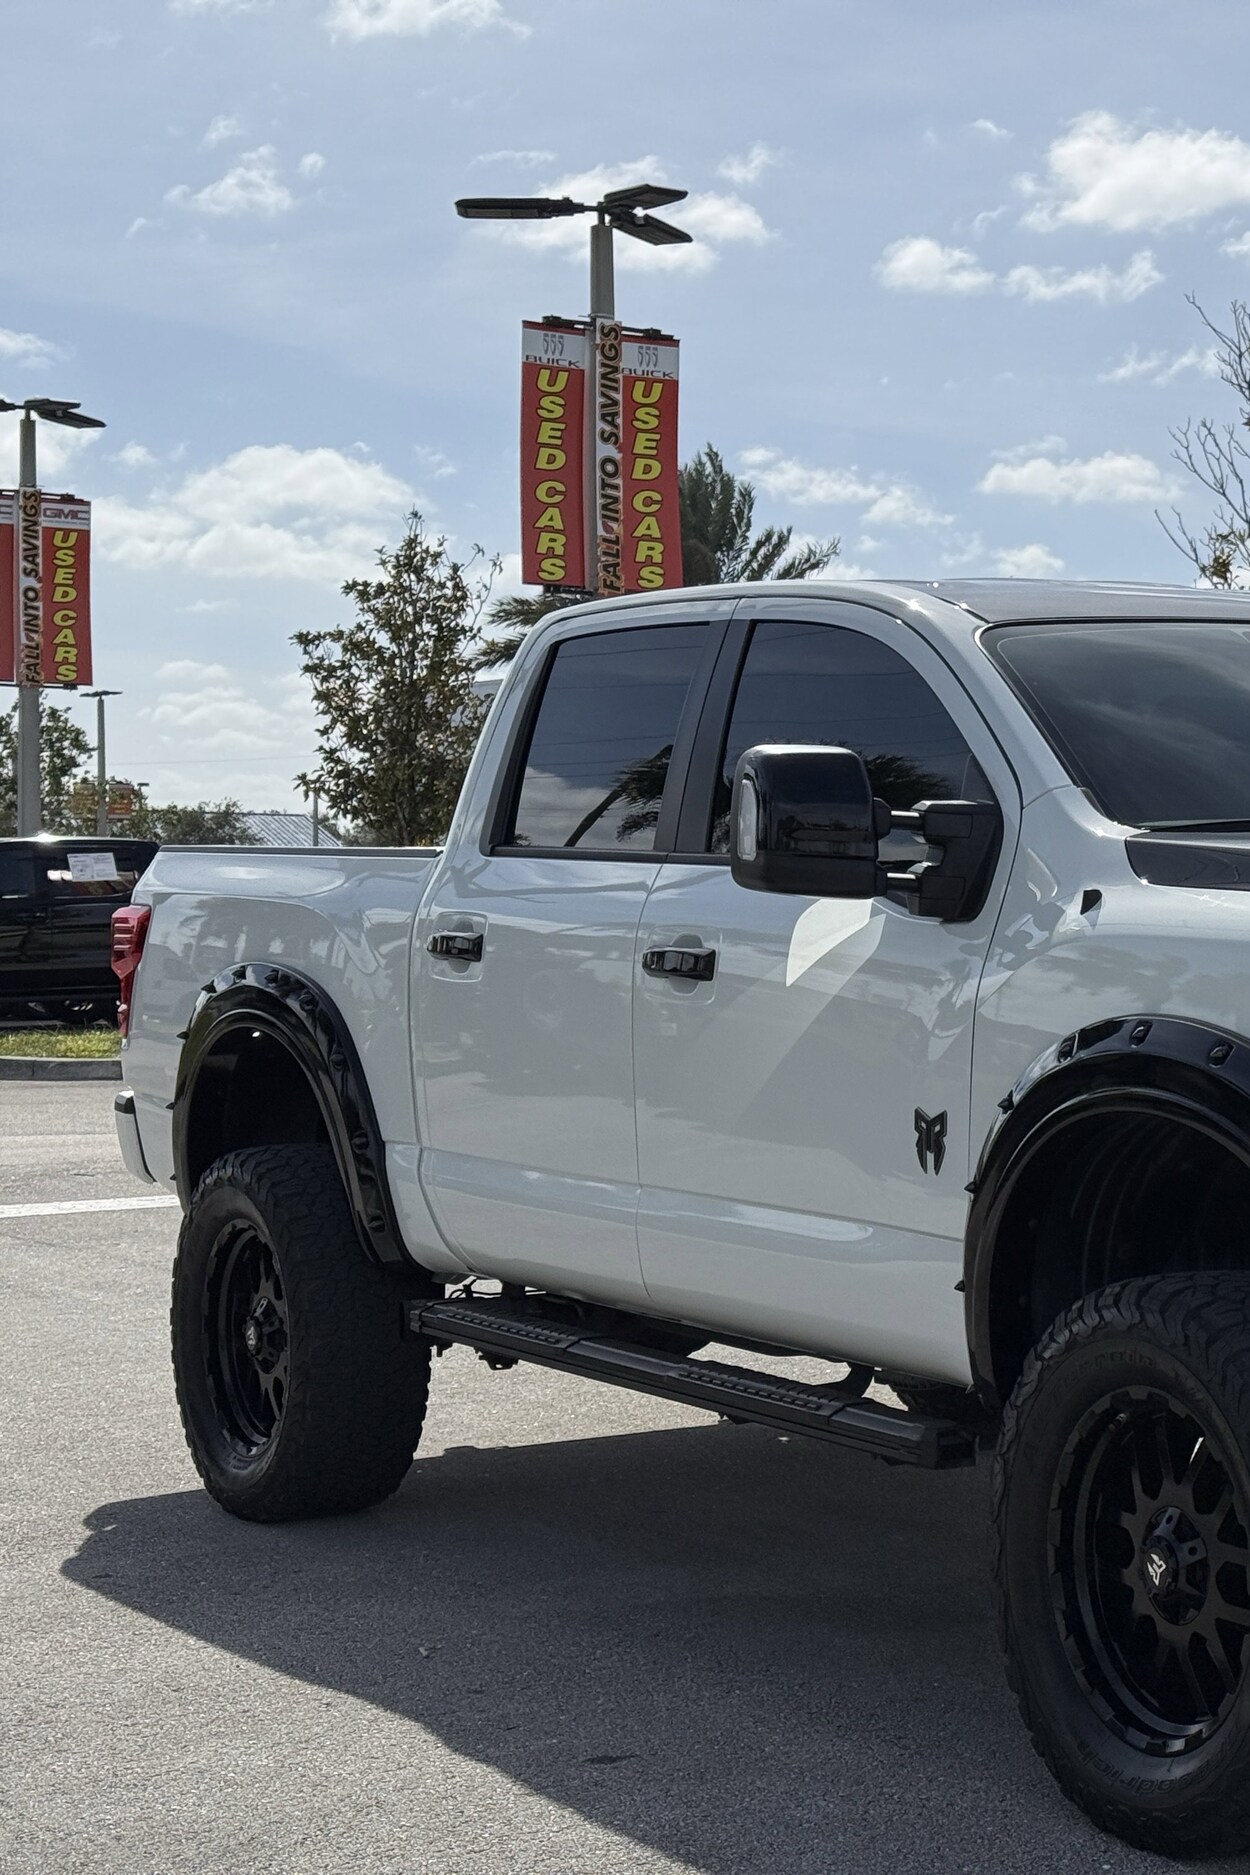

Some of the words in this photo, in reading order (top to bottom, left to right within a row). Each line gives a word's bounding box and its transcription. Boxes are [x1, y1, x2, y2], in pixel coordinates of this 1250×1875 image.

[525, 354, 580, 368] BUICK
[600, 323, 621, 448] SAVINGS
[621, 367, 674, 379] BUICK
[534, 367, 569, 471] USED
[631, 380, 664, 480] USED
[42, 507, 90, 521] GMC
[600, 455, 621, 523] INTO
[22, 489, 40, 579] SAVINGS
[52, 529, 78, 604] USED
[533, 480, 567, 582] CARS
[601, 535, 622, 593] FALL
[631, 489, 665, 589] CARS
[23, 587, 40, 634] INTO
[52, 609, 78, 682] CARS
[24, 641, 41, 684] FALL
